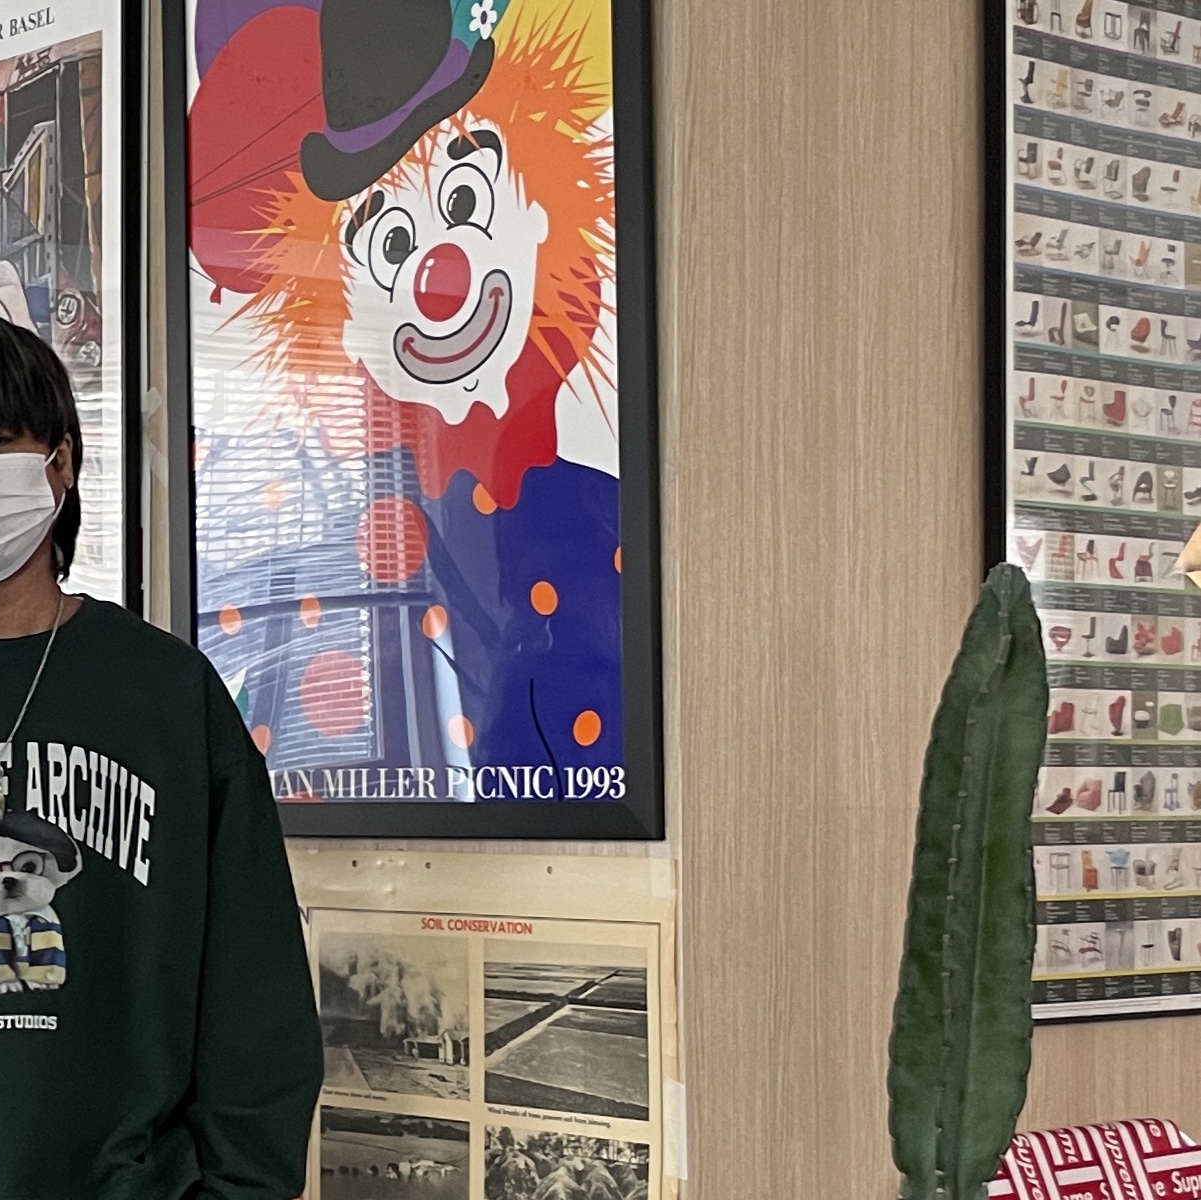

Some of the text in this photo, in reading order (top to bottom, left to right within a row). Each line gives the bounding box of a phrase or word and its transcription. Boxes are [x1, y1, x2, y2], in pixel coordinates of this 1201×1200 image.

[9, 7, 55, 37] BASEL
[321, 768, 437, 799] MILLER
[445, 765, 553, 799] PICNIC
[564, 766, 626, 799] 1993
[26, 742, 155, 887] ARCHIVE
[421, 918, 532, 935] SOIL CONSERVATION
